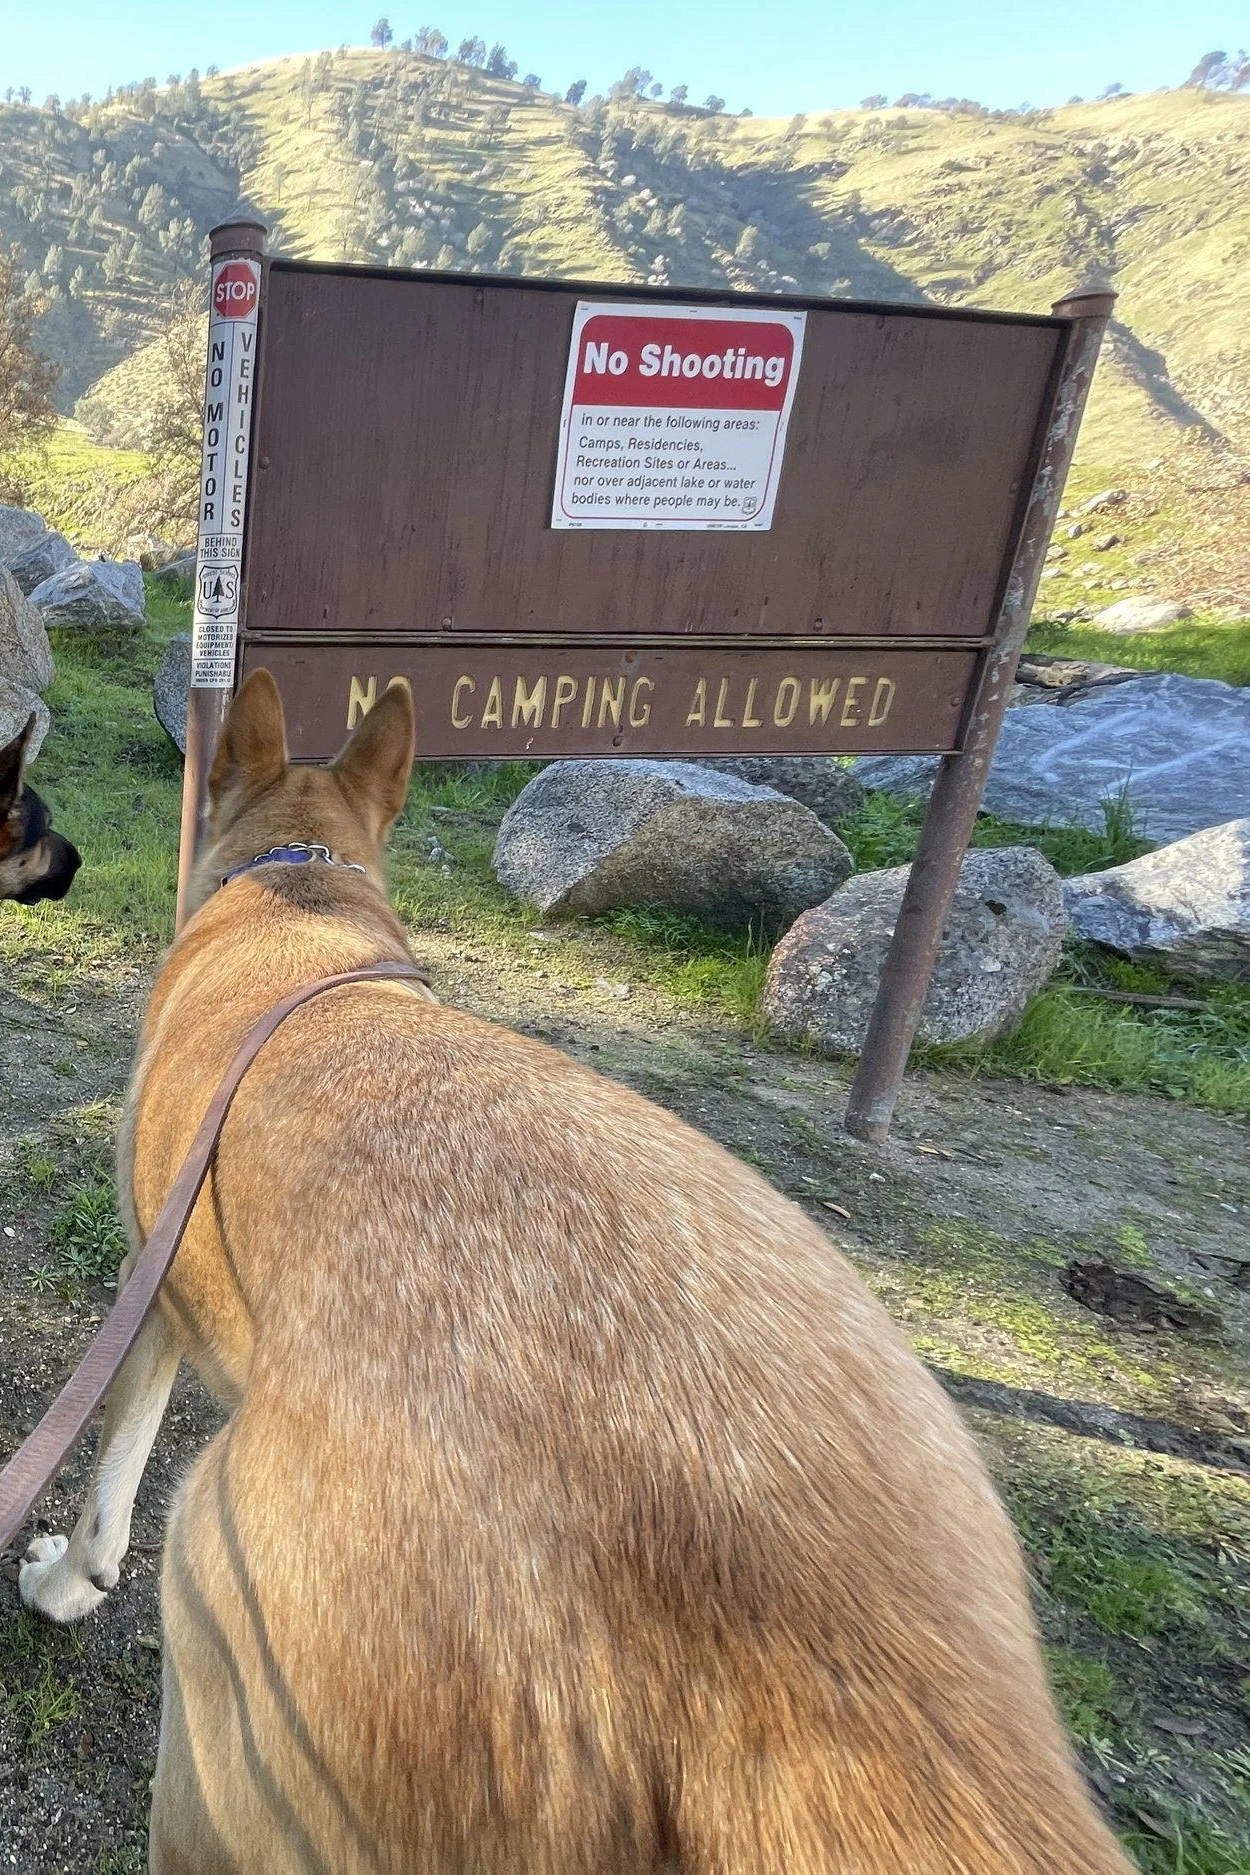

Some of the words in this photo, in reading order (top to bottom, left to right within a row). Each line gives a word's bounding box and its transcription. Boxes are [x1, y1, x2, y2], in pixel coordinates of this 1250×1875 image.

[216, 281, 255, 302] STOP
[211, 342, 225, 387] NO
[583, 342, 628, 375] No
[638, 344, 785, 387] Shooting
[230, 332, 252, 527] VEHICLES
[582, 413, 592, 424] in
[597, 416, 609, 426] or
[613, 415, 641, 427] near
[644, 415, 662, 428] the
[666, 416, 720, 432] following
[723, 419, 759, 430] areas:
[579, 436, 624, 451] Camps,
[628, 438, 703, 453] Residencies,
[204, 402, 224, 520] MOTOR
[576, 455, 640, 468] Recreation
[644, 457, 674, 469] Sites
[677, 459, 690, 470] or
[693, 458, 736, 470] Areas...
[574, 476, 594, 485] nor
[597, 476, 623, 486] over
[627, 476, 677, 489] adjacent
[680, 477, 704, 488] lake
[708, 479, 720, 489] or
[724, 478, 756, 489] water
[572, 493, 611, 505] bodies
[615, 493, 649, 505] where
[653, 494, 692, 508] people
[696, 497, 721, 509] may
[724, 495, 740, 507] be.
[205, 537, 237, 547] BEHIND
[201, 548, 218, 558] THIS
[222, 548, 240, 557] SIGN
[451, 674, 654, 729] CAMPING
[686, 676, 898, 728] ALLOWED
